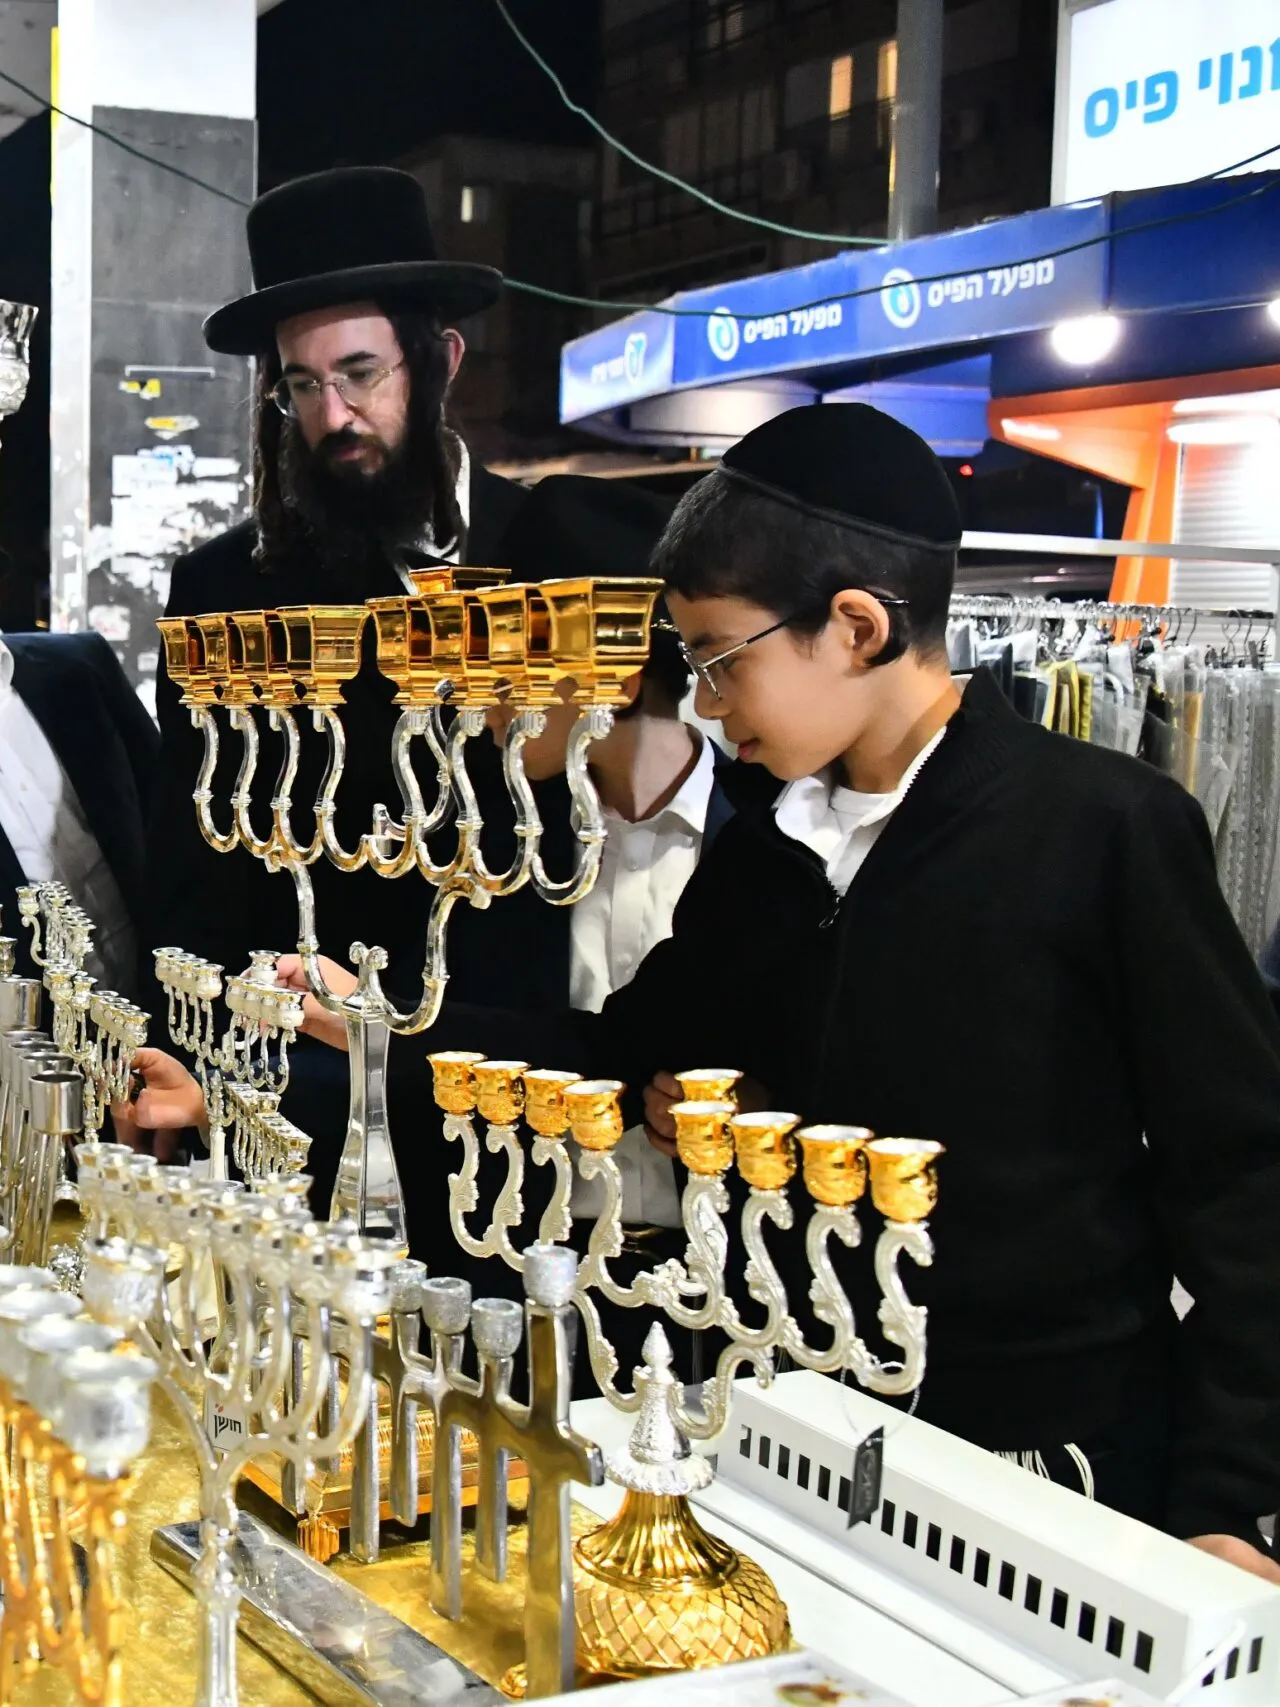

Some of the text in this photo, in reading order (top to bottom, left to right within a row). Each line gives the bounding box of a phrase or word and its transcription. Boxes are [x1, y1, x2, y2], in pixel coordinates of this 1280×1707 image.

[1084, 69, 1179, 139] פיס
[927, 258, 1055, 308] מפעל הפיס
[743, 303, 842, 344] מפעל הפיס
[213, 1414, 242, 1439] חושן
